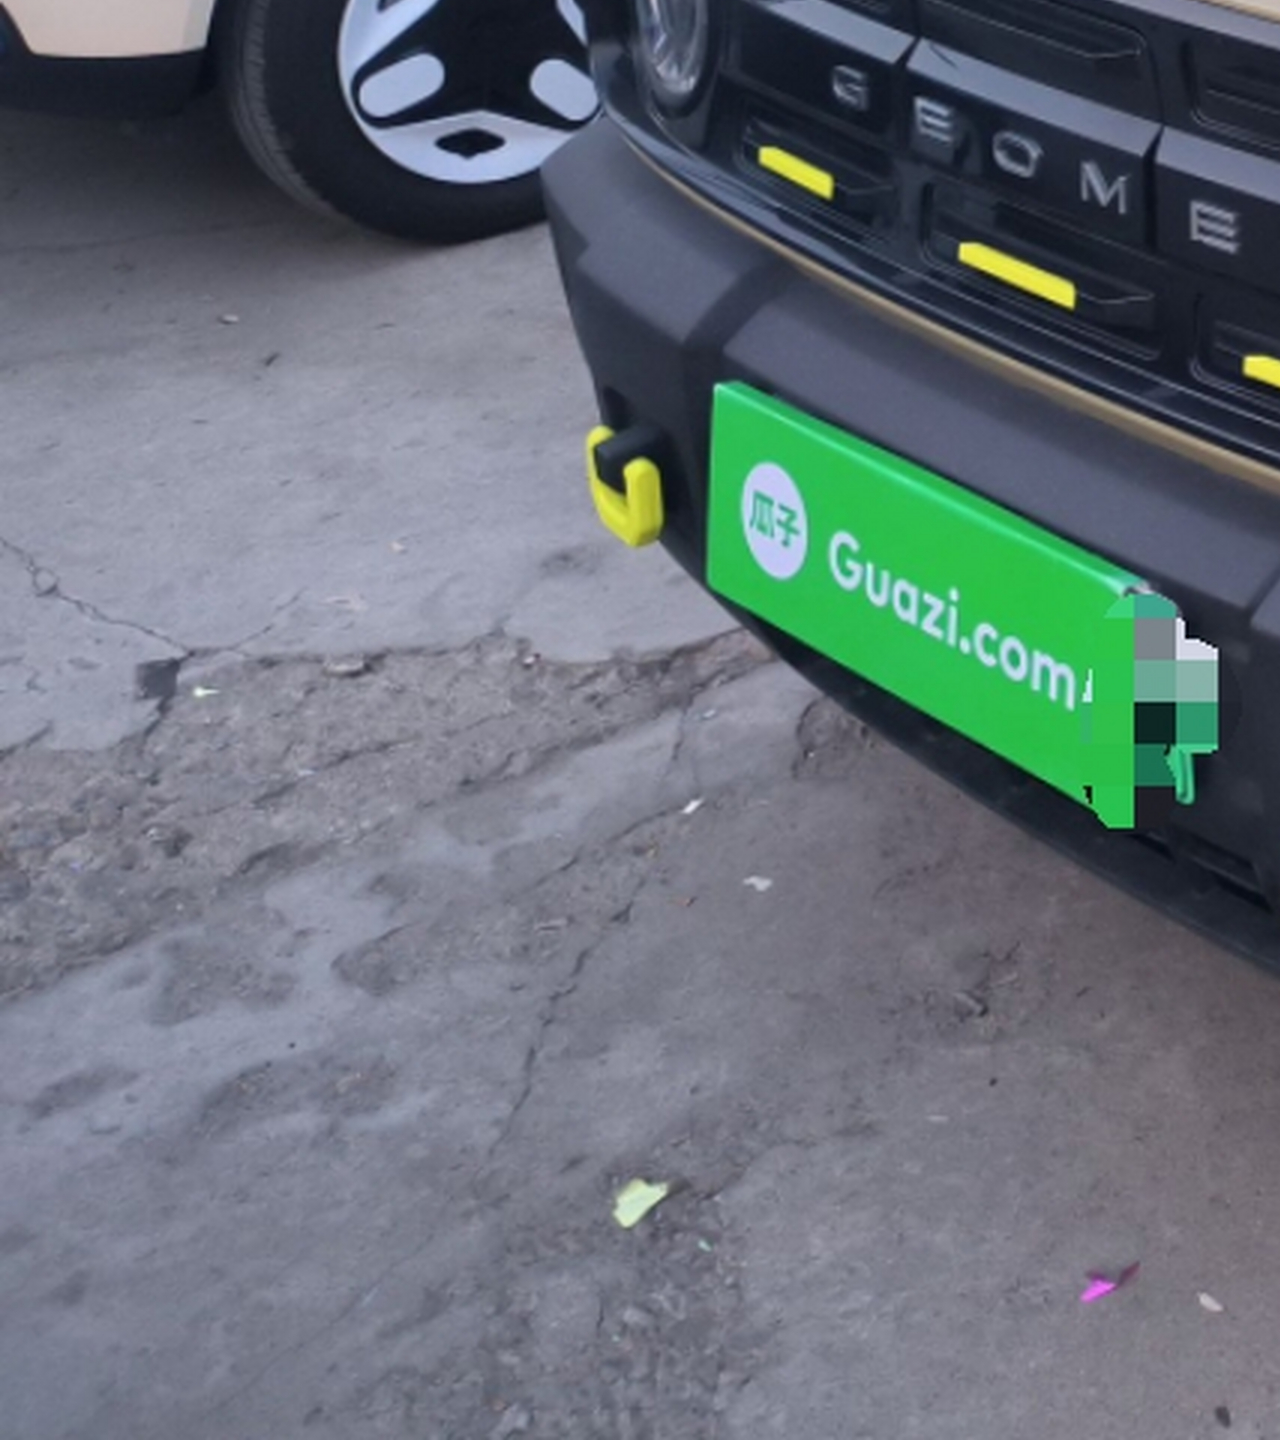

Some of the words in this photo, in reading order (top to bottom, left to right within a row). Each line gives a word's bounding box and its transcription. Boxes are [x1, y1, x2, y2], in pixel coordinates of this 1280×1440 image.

[831, 65, 1240, 254] GEOME
[749, 490, 801, 548] 瓜子
[828, 530, 1077, 713] Guazi.com
